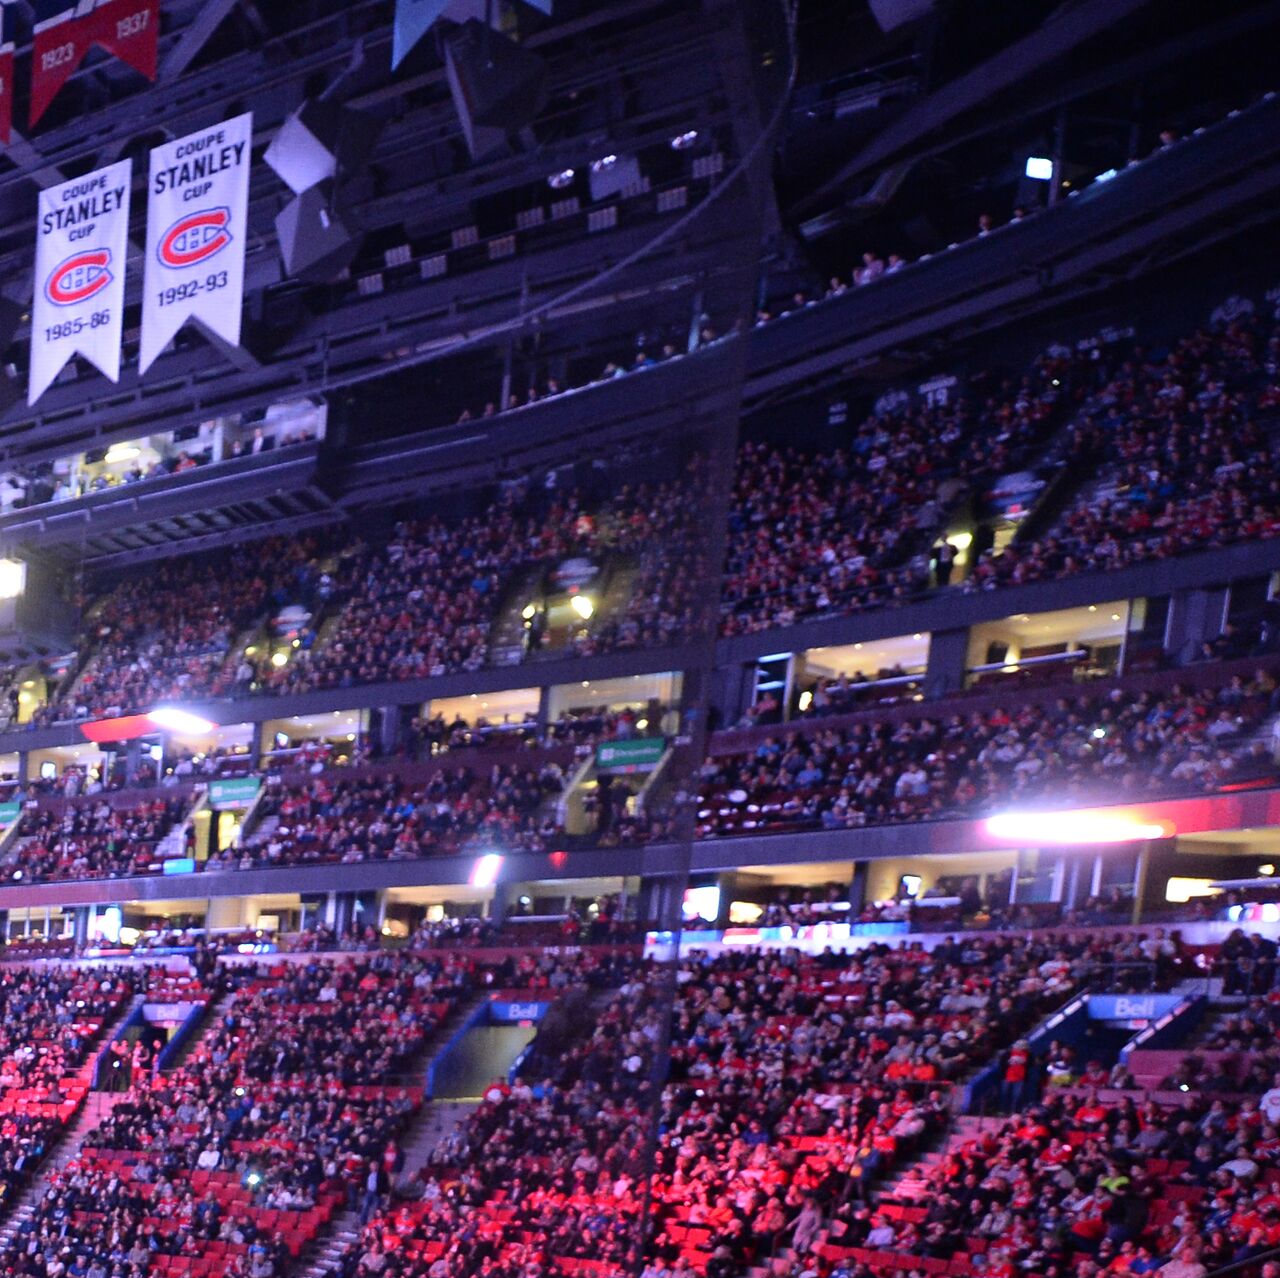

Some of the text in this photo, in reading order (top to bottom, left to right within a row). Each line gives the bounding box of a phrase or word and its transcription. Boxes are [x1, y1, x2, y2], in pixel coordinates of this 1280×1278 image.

[116, 10, 149, 39] 1937
[42, 43, 75, 71] 1923
[175, 130, 225, 160] COUPE
[154, 141, 247, 195] STANLEY
[63, 175, 107, 202] COUPE
[183, 182, 213, 201] CUP
[43, 186, 126, 235] STANLEY
[69, 225, 96, 242] CUP
[158, 271, 228, 307] 1992-93
[46, 310, 110, 342] 1985-86
[508, 1003, 538, 1020] Bell
[1114, 998, 1154, 1017] Bell
